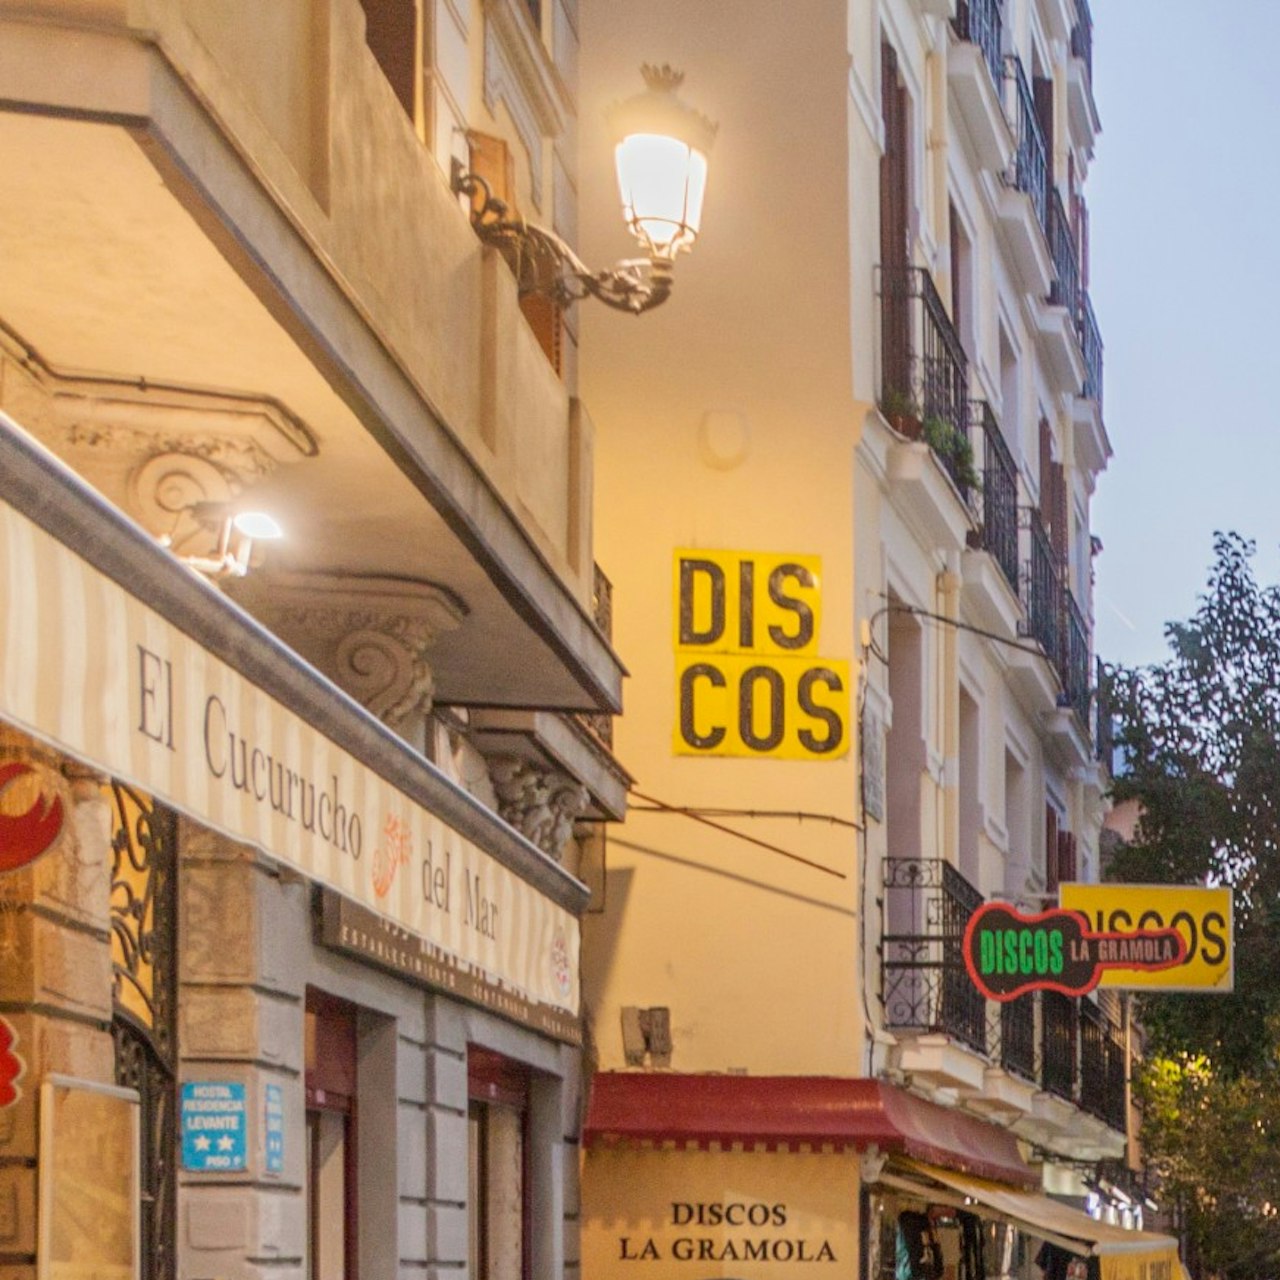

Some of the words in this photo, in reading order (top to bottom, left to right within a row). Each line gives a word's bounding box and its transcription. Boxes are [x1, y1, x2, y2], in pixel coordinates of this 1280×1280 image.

[679, 558, 815, 650] DIS
[680, 663, 844, 754] COS
[137, 644, 177, 752] El
[203, 694, 363, 861] Cucurucho
[421, 840, 451, 914] del
[464, 866, 500, 941] Mar
[980, 929, 1065, 975] DISCOS
[1071, 939, 1090, 961] LA
[1099, 938, 1174, 962] GRAMOLA
[193, 1086, 231, 1098] HOSTAL
[187, 1116, 239, 1130] LEVANTE
[671, 1203, 787, 1227] DISCOS
[619, 1237, 661, 1260] LA
[671, 1237, 838, 1262] GRAMOLA
